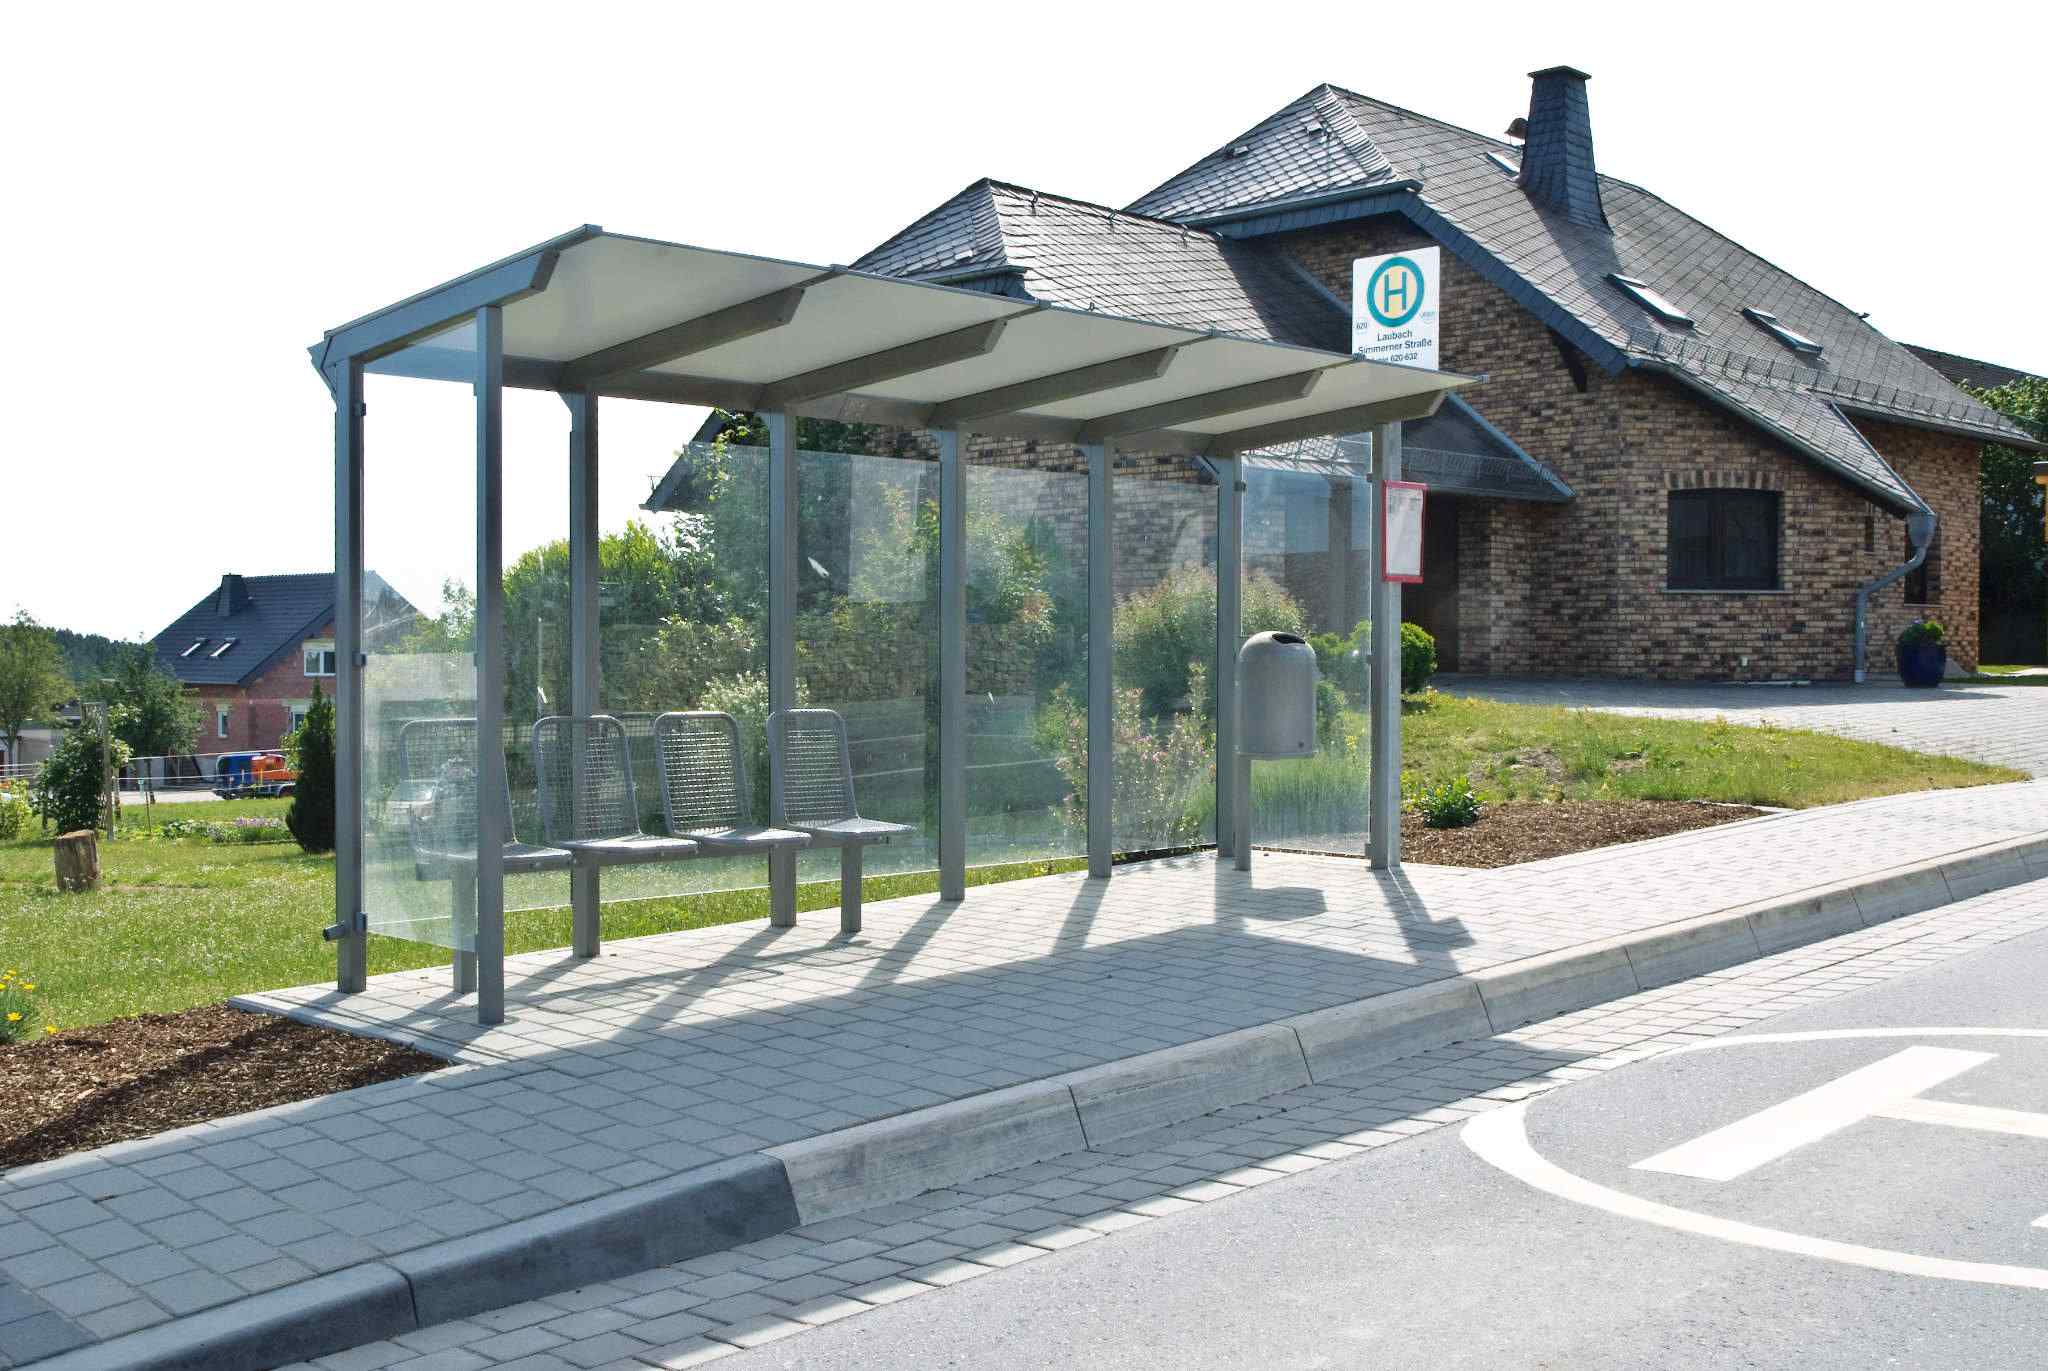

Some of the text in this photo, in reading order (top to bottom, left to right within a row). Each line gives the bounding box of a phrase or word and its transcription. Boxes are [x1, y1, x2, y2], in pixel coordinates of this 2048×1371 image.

[1383, 271, 1407, 313] H
[1377, 329, 1413, 342] Laubach
[1358, 338, 1432, 354] Simmerner Straße
